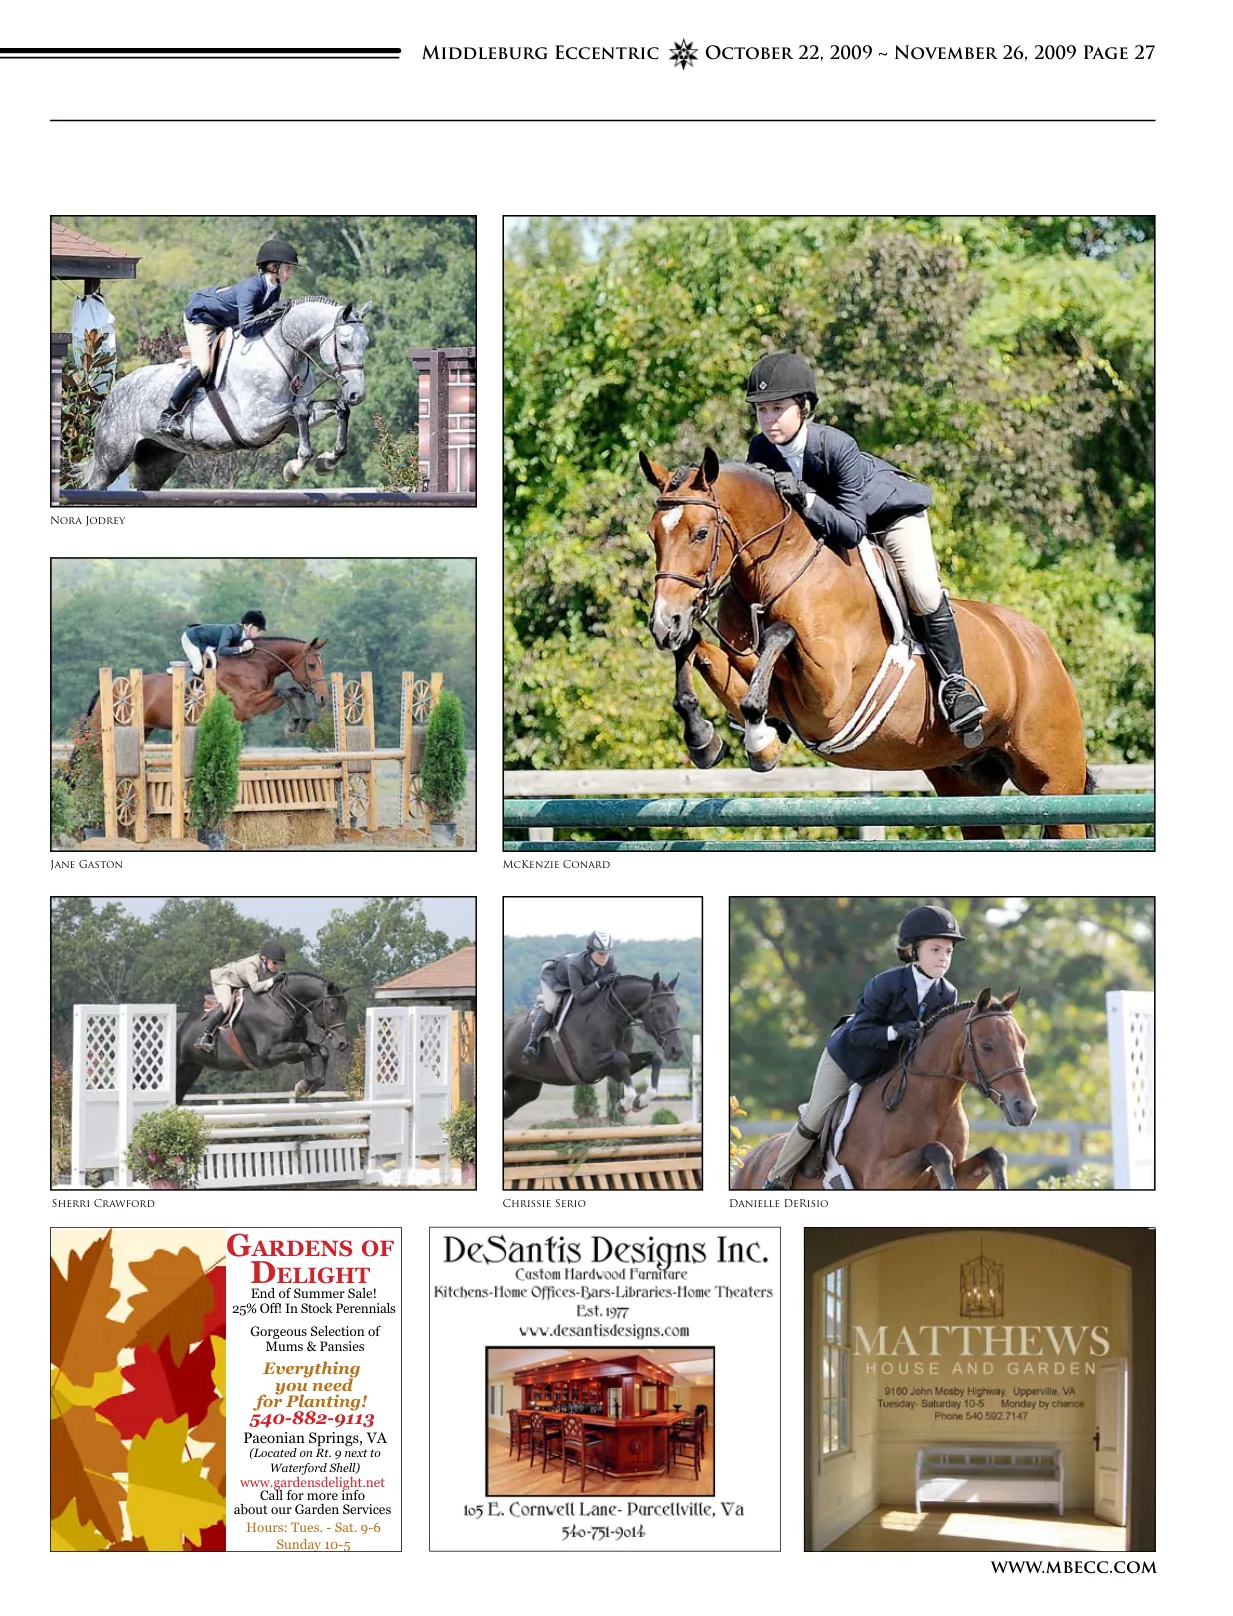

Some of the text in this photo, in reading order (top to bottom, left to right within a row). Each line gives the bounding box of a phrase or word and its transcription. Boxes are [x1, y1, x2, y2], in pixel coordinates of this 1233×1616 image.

[421, 44, 660, 60] MIDDLEBURG ECCENTRIC
[705, 44, 1156, 62] OCTOBER 22, 2009 NOVEMBER 26, 2009 PAGE 27
[50, 515, 126, 527] NORA JODREY
[50, 859, 123, 871] JANE GASTON
[502, 859, 611, 869] MCKENZIE CONARD
[51, 1198, 156, 1208] SHERRI CRAWFORD
[502, 1198, 587, 1208] CHRISSIE SERIO
[729, 1198, 829, 1208] DANIELLE DERISIO
[226, 1232, 395, 1258] GARDENS OF
[443, 1234, 769, 1271] DeSantis Designs Inc.
[250, 1260, 371, 1285] DELIGHT
[250, 1287, 377, 1299] End of Summer Sale!
[576, 1304, 630, 1320] Est. 1977
[518, 1323, 690, 1340] www.desantisdesigns.com
[853, 1325, 1111, 1357] MATTHEWS
[262, 1360, 361, 1378] Everything
[866, 1362, 1097, 1375] HOUSE AND GARDEN
[274, 1377, 354, 1395] you need
[252, 1393, 368, 1411] for Planting!
[248, 1410, 375, 1429] 540-882-9113
[934, 1412, 963, 1421] Phone
[243, 1431, 388, 1447] Paeonian Springs, VA
[239, 1476, 386, 1491] www.gardensdelight.net
[463, 1504, 484, 1520] 105
[508, 1501, 575, 1518] Cornwell
[579, 1501, 623, 1517] Lane-
[720, 1501, 745, 1517] Va
[561, 1523, 646, 1541] 540-751-9014
